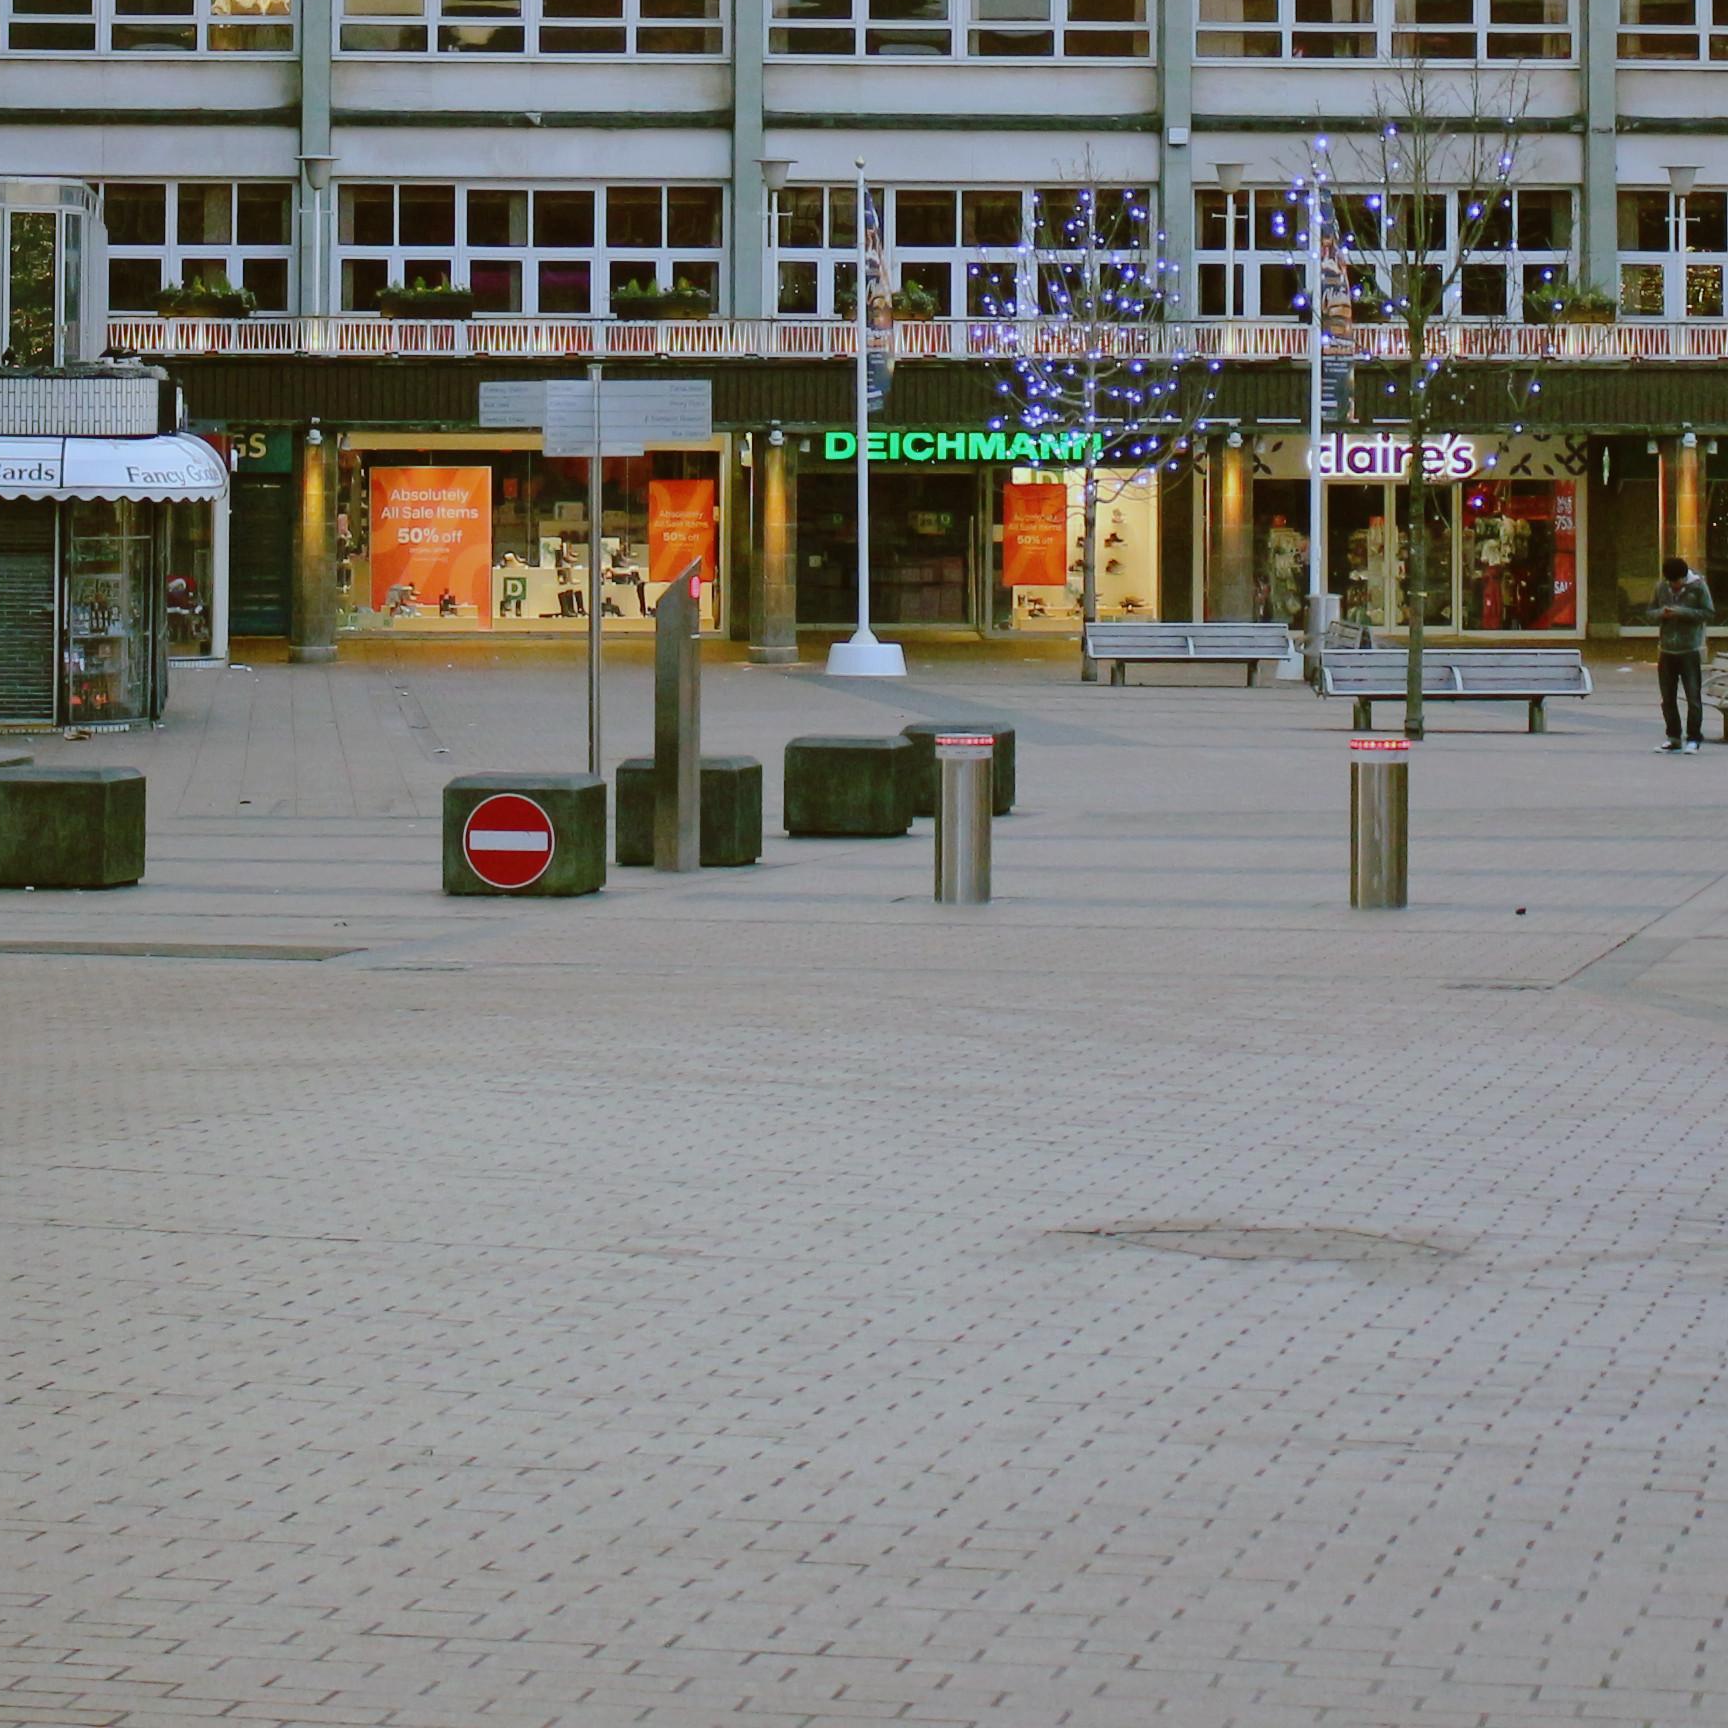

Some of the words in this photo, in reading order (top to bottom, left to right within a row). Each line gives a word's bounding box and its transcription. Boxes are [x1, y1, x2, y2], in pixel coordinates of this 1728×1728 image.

[825, 431, 1103, 461] DEICHMANN
[125, 464, 187, 486] Fancy
[390, 488, 469, 504] Absolutely
[380, 505, 400, 520] All
[401, 505, 434, 520] Sale
[436, 505, 480, 520] Items
[397, 527, 440, 544] 50%
[441, 529, 464, 543] off
[506, 580, 524, 597] D
